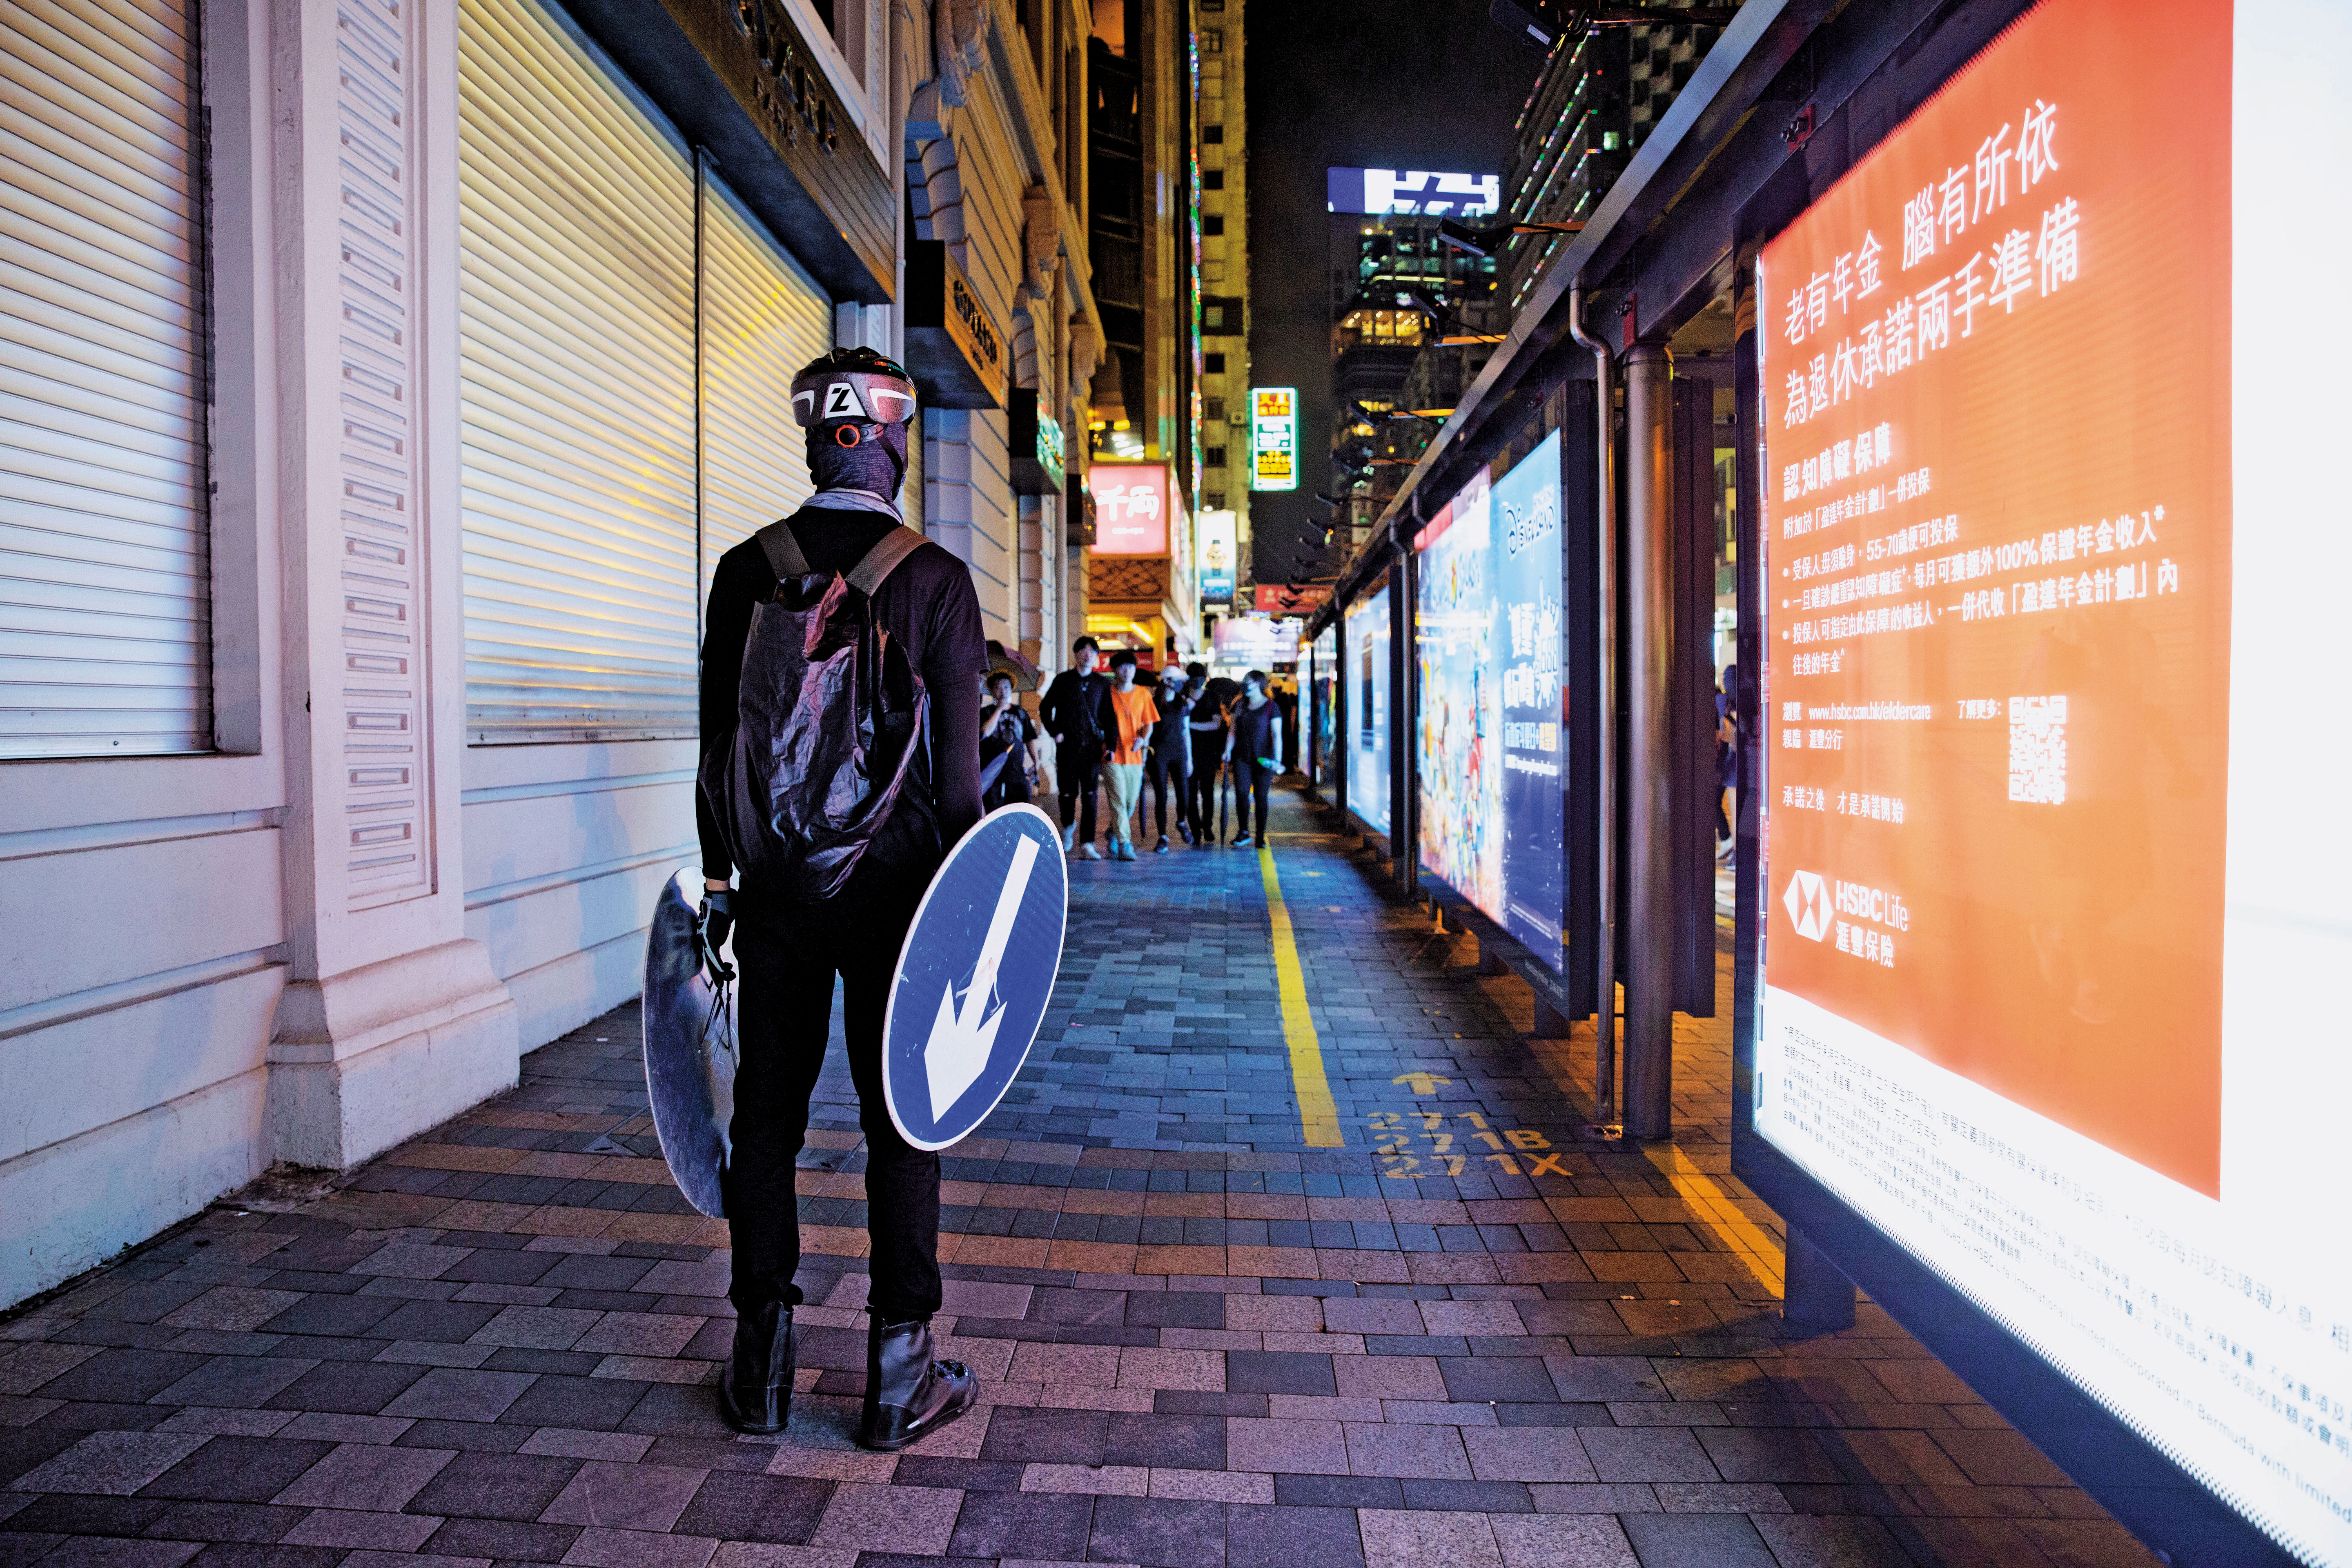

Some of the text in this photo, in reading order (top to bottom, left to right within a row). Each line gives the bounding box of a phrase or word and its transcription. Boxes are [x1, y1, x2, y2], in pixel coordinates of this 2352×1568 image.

[1784, 98, 2058, 345] 老有年金 腦有所依
[1784, 196, 2081, 429] 為退休承諾兩手準備
[1784, 421, 1891, 502] 認知障礙保障
[1809, 701, 1931, 720] www.hsbc.com.hk/eldercare
[1783, 786, 1904, 824] 承諾之後 才是承諾開始
[1836, 880, 1909, 932] HSBC Life
[1368, 1112, 1489, 1130] 271
[1374, 1130, 1551, 1154] 271B
[1382, 1153, 1573, 1179] 271X
[2198, 1402, 2254, 1456] Bermuda
[2261, 1447, 2289, 1480] with
[2296, 1471, 2351, 1524] limited
